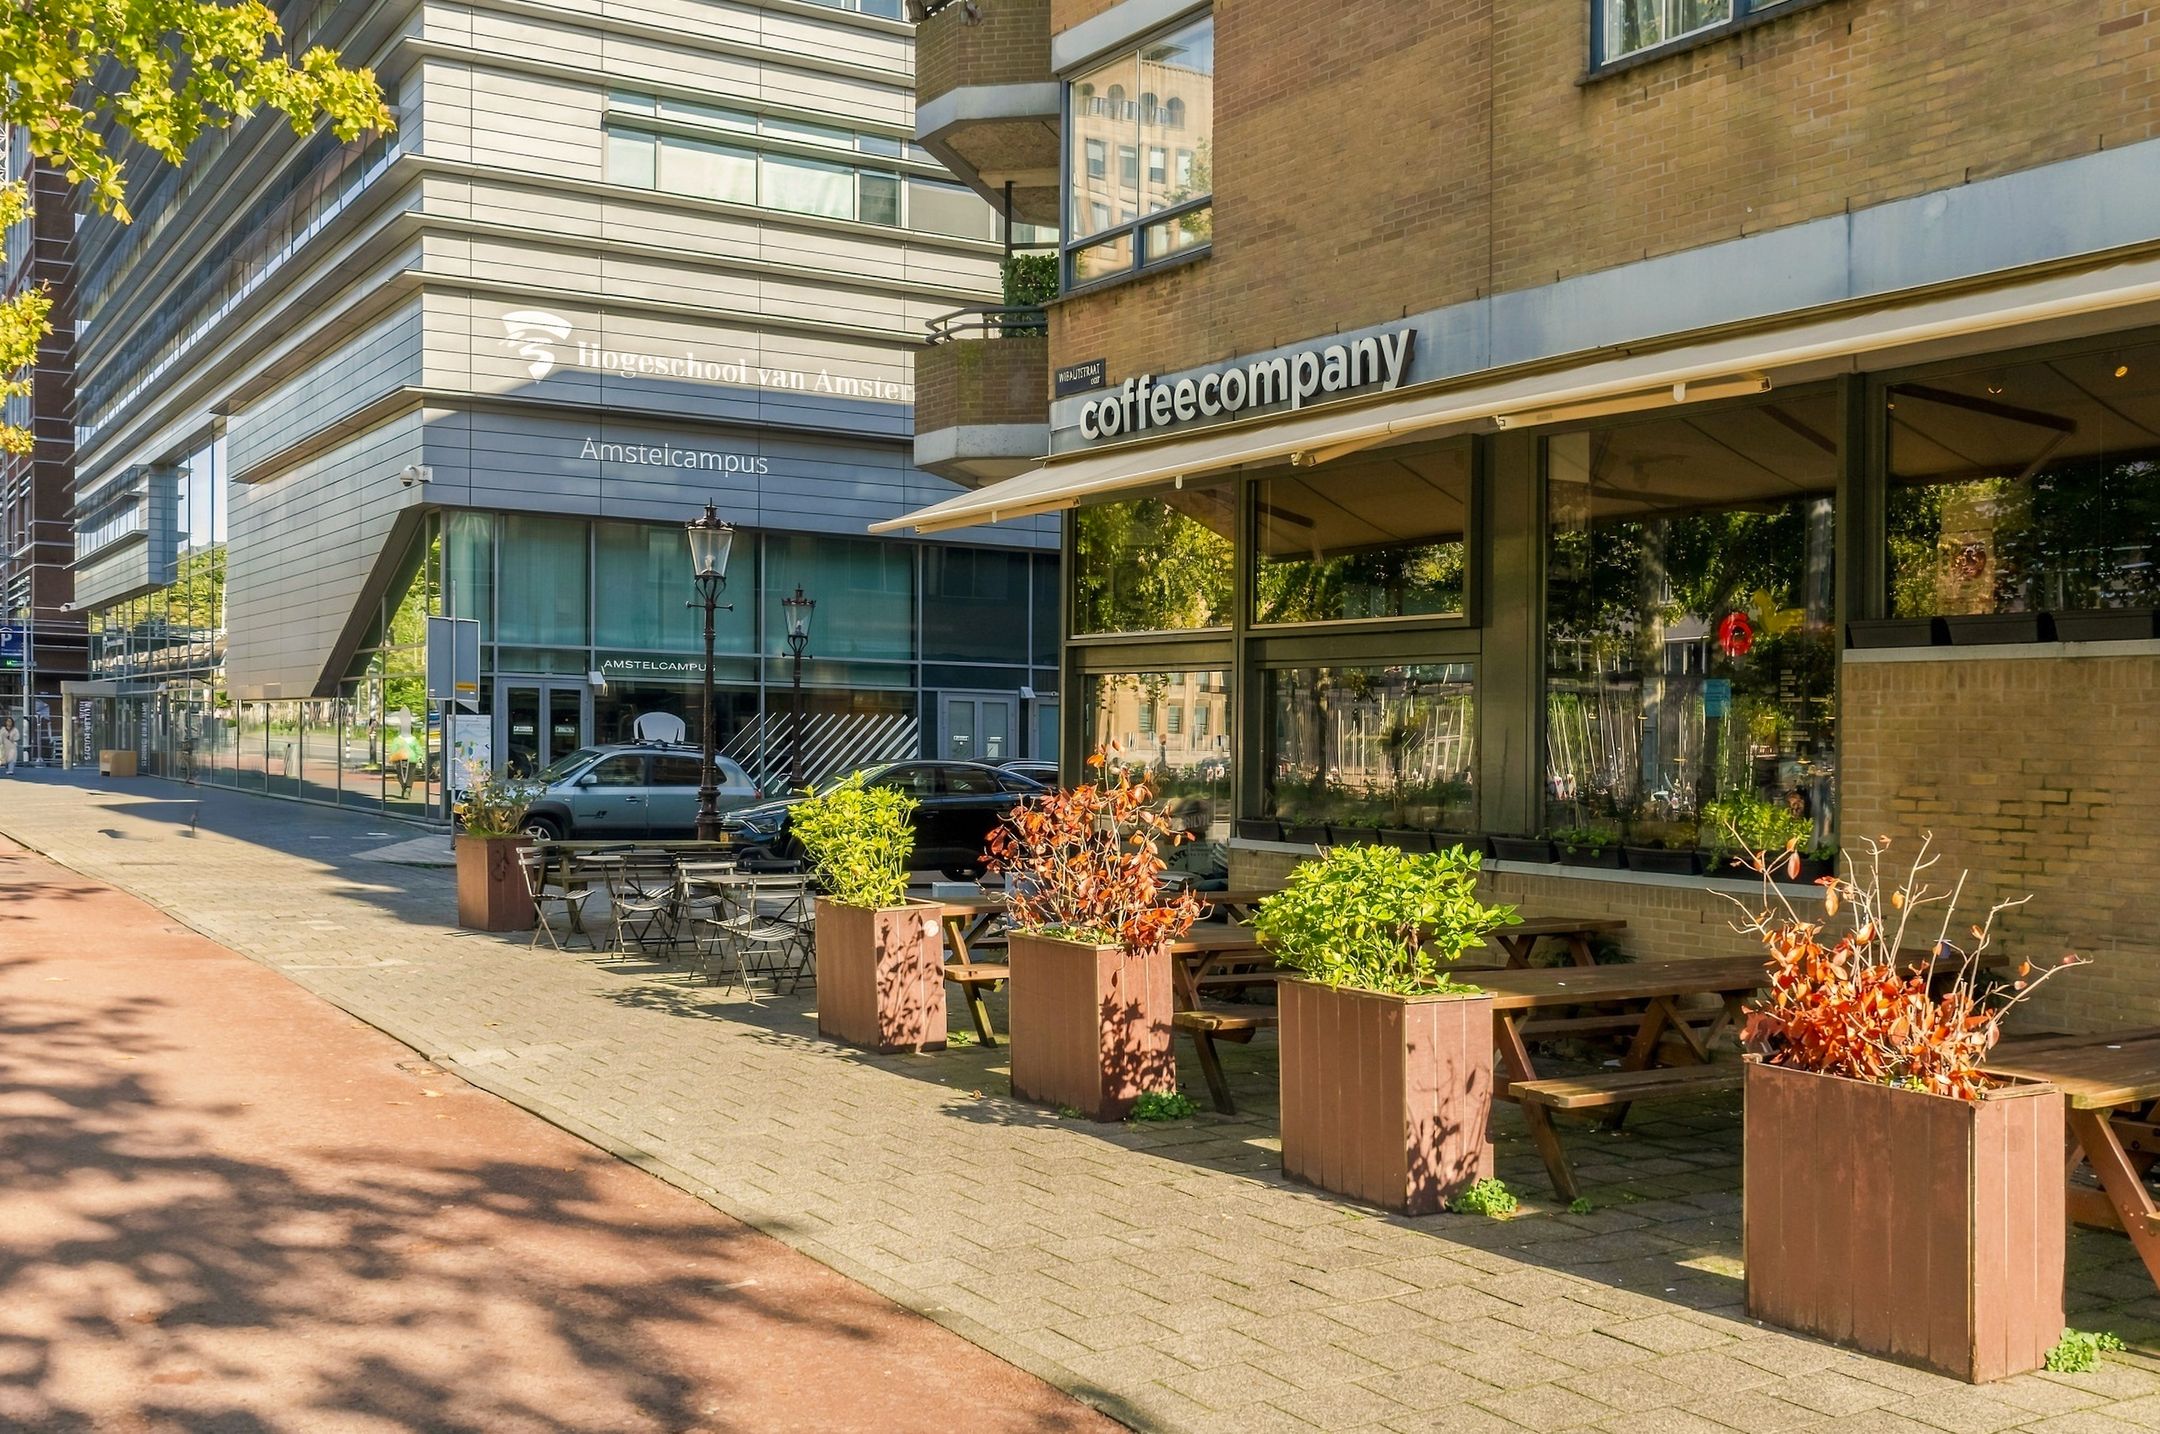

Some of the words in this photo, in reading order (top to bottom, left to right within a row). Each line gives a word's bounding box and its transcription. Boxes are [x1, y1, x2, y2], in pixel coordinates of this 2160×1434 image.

[577, 341, 749, 384] Hogeschool
[757, 368, 805, 390] van
[1080, 328, 1416, 440] coffeecompany
[580, 437, 768, 477] Amstelcampus
[603, 659, 716, 672] AMSTELCAMPU
